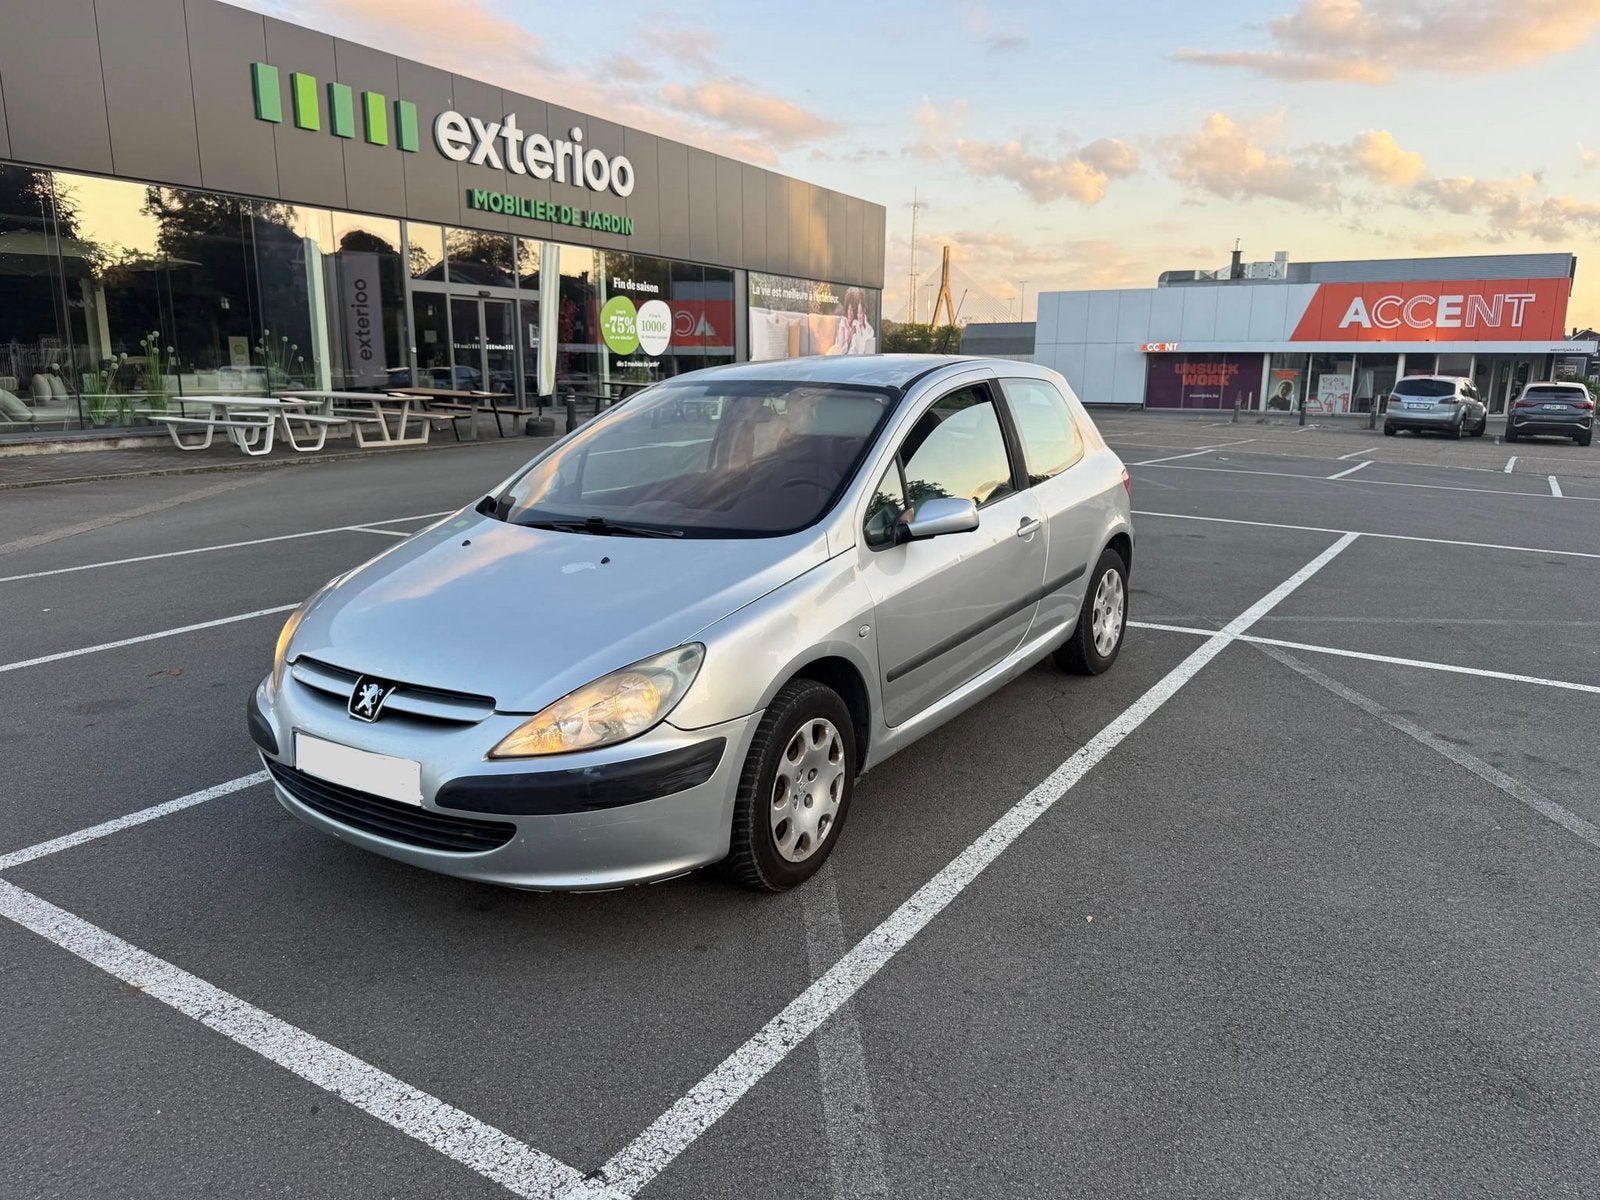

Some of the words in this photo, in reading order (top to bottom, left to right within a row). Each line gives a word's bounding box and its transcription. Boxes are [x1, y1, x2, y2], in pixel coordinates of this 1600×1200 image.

[434, 110, 635, 197] exterioo
[471, 188, 557, 223] MOBILIER
[560, 205, 581, 226] DE
[585, 209, 635, 236] JARDIN
[613, 277, 626, 289] Fin
[626, 279, 636, 290] de
[636, 281, 659, 293] saison
[752, 284, 760, 295] La
[760, 284, 770, 297] vie
[772, 287, 782, 298] est
[1338, 293, 1537, 329] ACCENT
[351, 279, 373, 361] exterioo
[605, 315, 636, 334] -75%
[1141, 343, 1178, 351] ACCENT
[1174, 363, 1239, 374] UNSUCK
[1183, 374, 1230, 386] WORK
